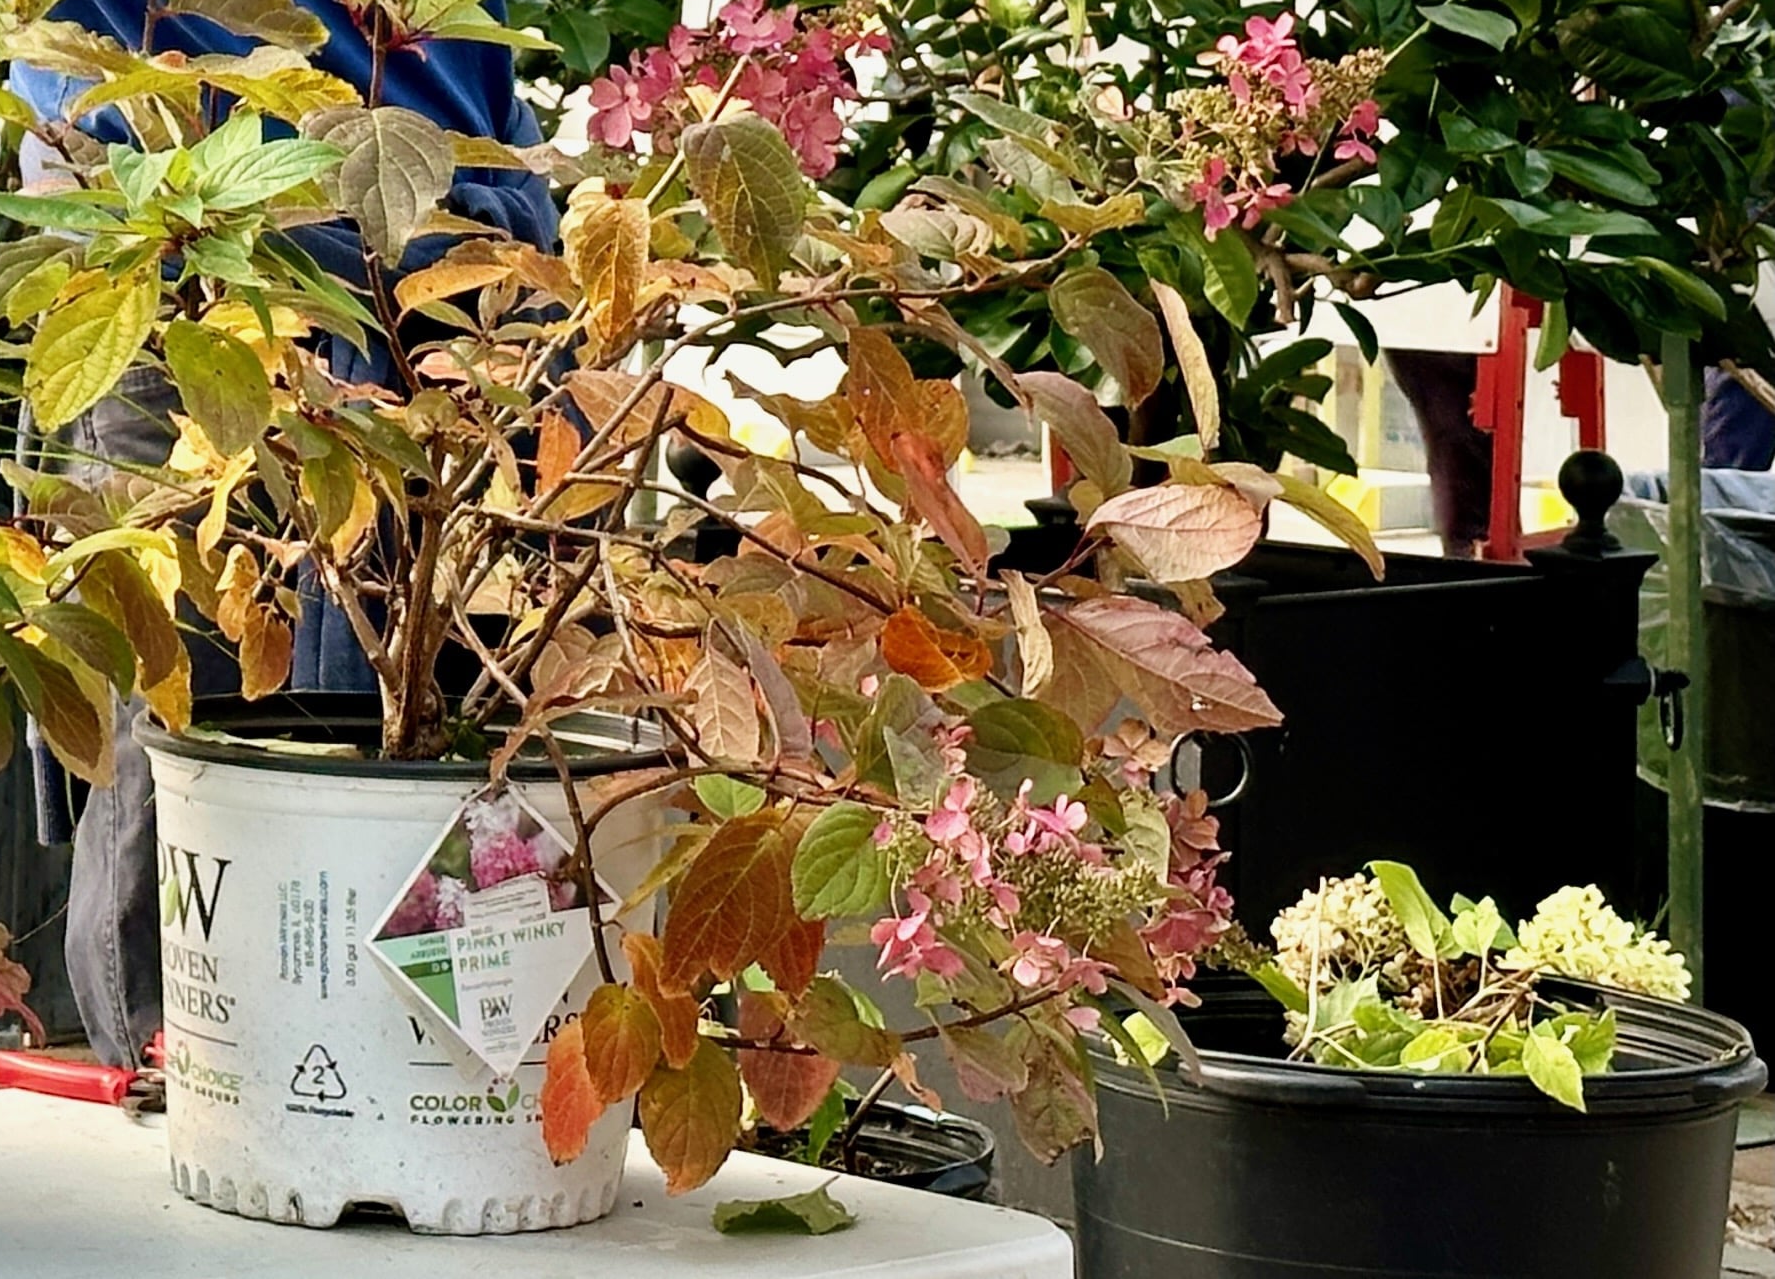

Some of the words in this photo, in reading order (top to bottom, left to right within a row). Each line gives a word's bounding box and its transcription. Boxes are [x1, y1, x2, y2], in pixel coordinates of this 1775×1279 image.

[457, 932, 506, 952] PINKY
[512, 921, 566, 943] WINKY
[162, 938, 218, 984] OVEN
[458, 950, 511, 973] PRIME
[312, 1066, 325, 1084] 2
[410, 1095, 483, 1112] COLOR
[410, 1115, 515, 1125] FLOWERING
